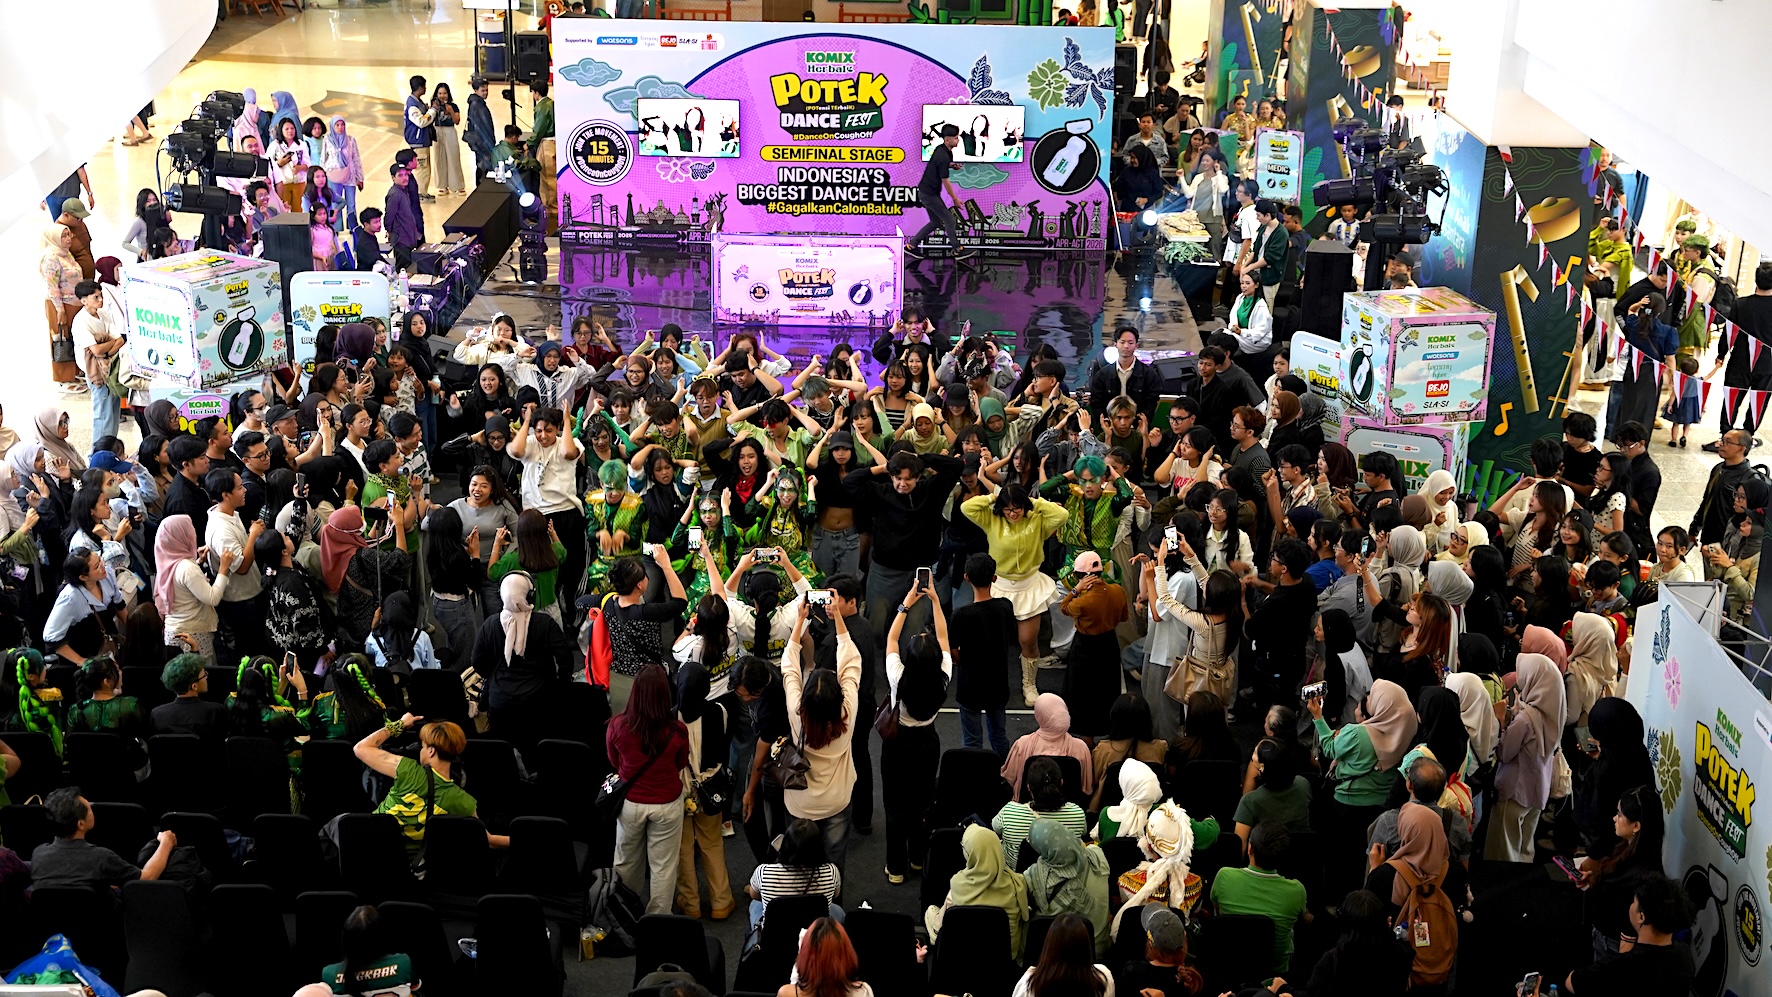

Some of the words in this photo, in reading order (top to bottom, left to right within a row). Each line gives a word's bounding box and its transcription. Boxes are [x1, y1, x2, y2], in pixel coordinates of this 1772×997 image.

[806, 53, 854, 63] KOMIX
[808, 65, 854, 73] Herbals
[770, 72, 888, 107] POTEK
[781, 113, 841, 128] DANCE
[844, 112, 879, 127] FEST
[793, 131, 872, 141] #DanceOnCoughOff
[590, 140, 609, 155] 15
[587, 155, 615, 163] MINUTES
[772, 148, 846, 161] SEMIFINAL
[850, 149, 893, 161] STAGE
[778, 167, 885, 184] INDONESIA'S
[1267, 164, 1289, 174] MEDIC
[738, 184, 807, 201] BIGGEST
[812, 186, 869, 202] DANCE
[873, 187, 920, 202] EVEN
[767, 201, 902, 215] #GagalkanCalonBatuk
[578, 231, 603, 239] POTEK
[1086, 239, 1104, 249] 2026
[778, 268, 836, 285] POTEK
[225, 280, 249, 293] POTEK
[784, 287, 813, 296] DANCE
[320, 303, 362, 316] POTEK
[135, 306, 182, 331] KOMIX
[138, 329, 184, 345] Herbals
[1427, 335, 1456, 344] KOMIX
[1426, 352, 1455, 360] watsons
[1308, 369, 1339, 391] POTEK
[1427, 383, 1449, 393] BEJO
[188, 400, 221, 409] KOMIX
[1716, 707, 1742, 749] KOMIX
[1715, 723, 1738, 759] Herbals
[1695, 721, 1755, 828] POTEK
[1694, 774, 1726, 830] DANCE
[1725, 821, 1745, 844] FEST
[1744, 906, 1754, 930] 15
